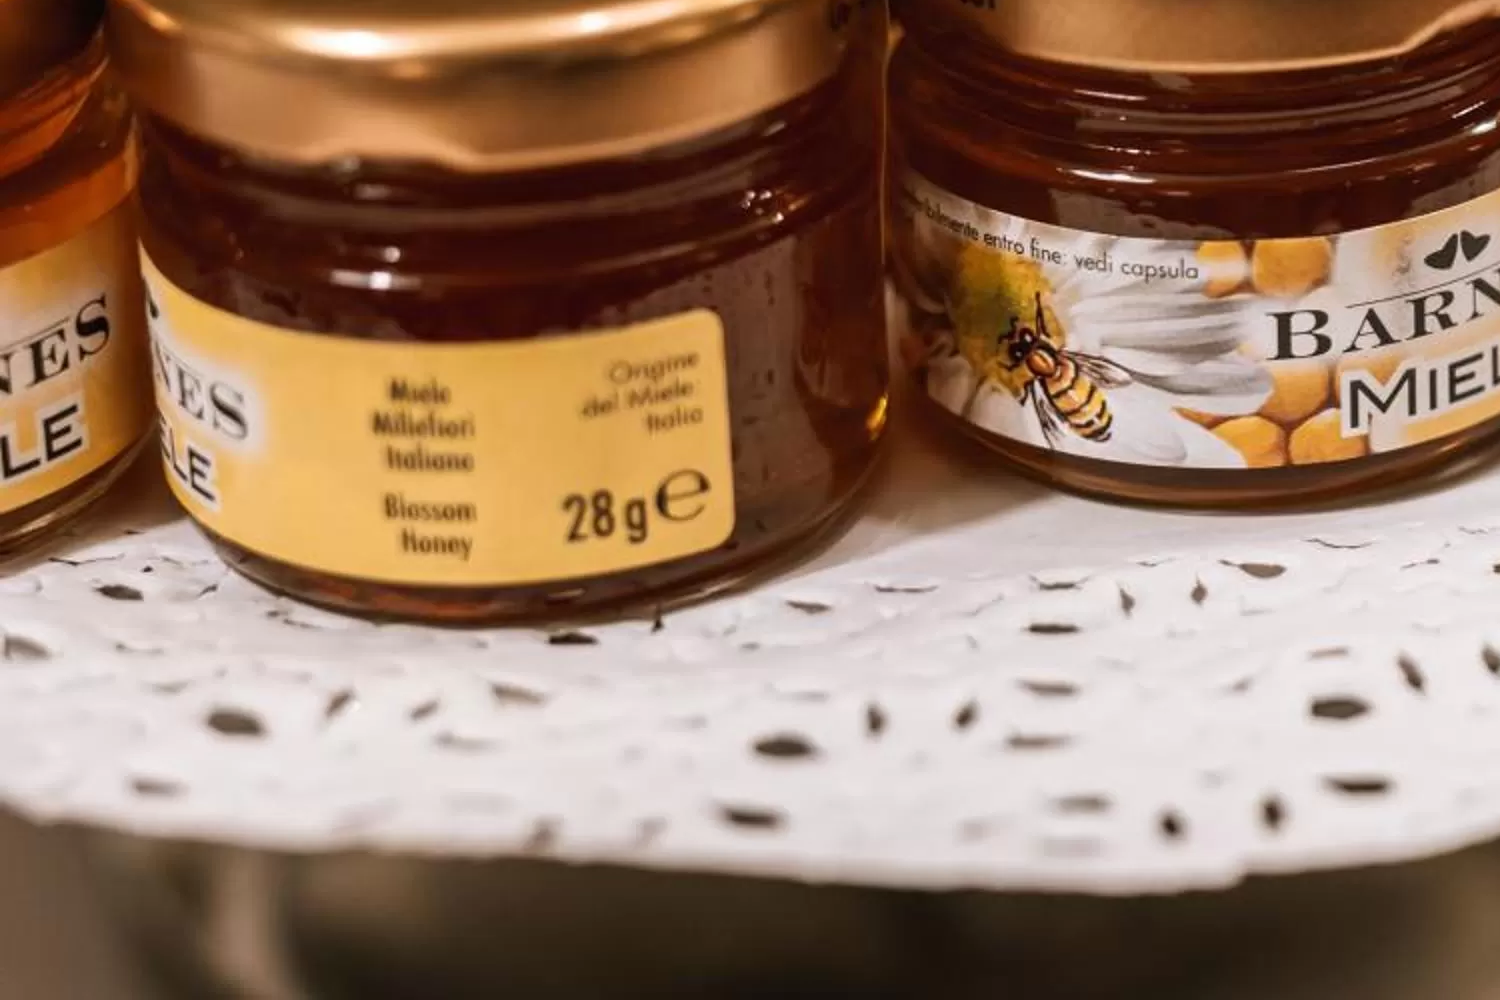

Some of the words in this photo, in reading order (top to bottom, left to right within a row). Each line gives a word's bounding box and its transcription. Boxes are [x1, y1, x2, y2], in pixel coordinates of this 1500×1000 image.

[983, 231, 1025, 255] entro
[1030, 238, 1067, 265] fine:
[1074, 253, 1113, 273] vedi
[1120, 259, 1199, 284] capsula
[609, 353, 699, 384] Origine
[582, 393, 619, 418] del
[627, 378, 694, 408] Miele
[384, 491, 477, 521] Blossom
[401, 527, 472, 561] Honey
